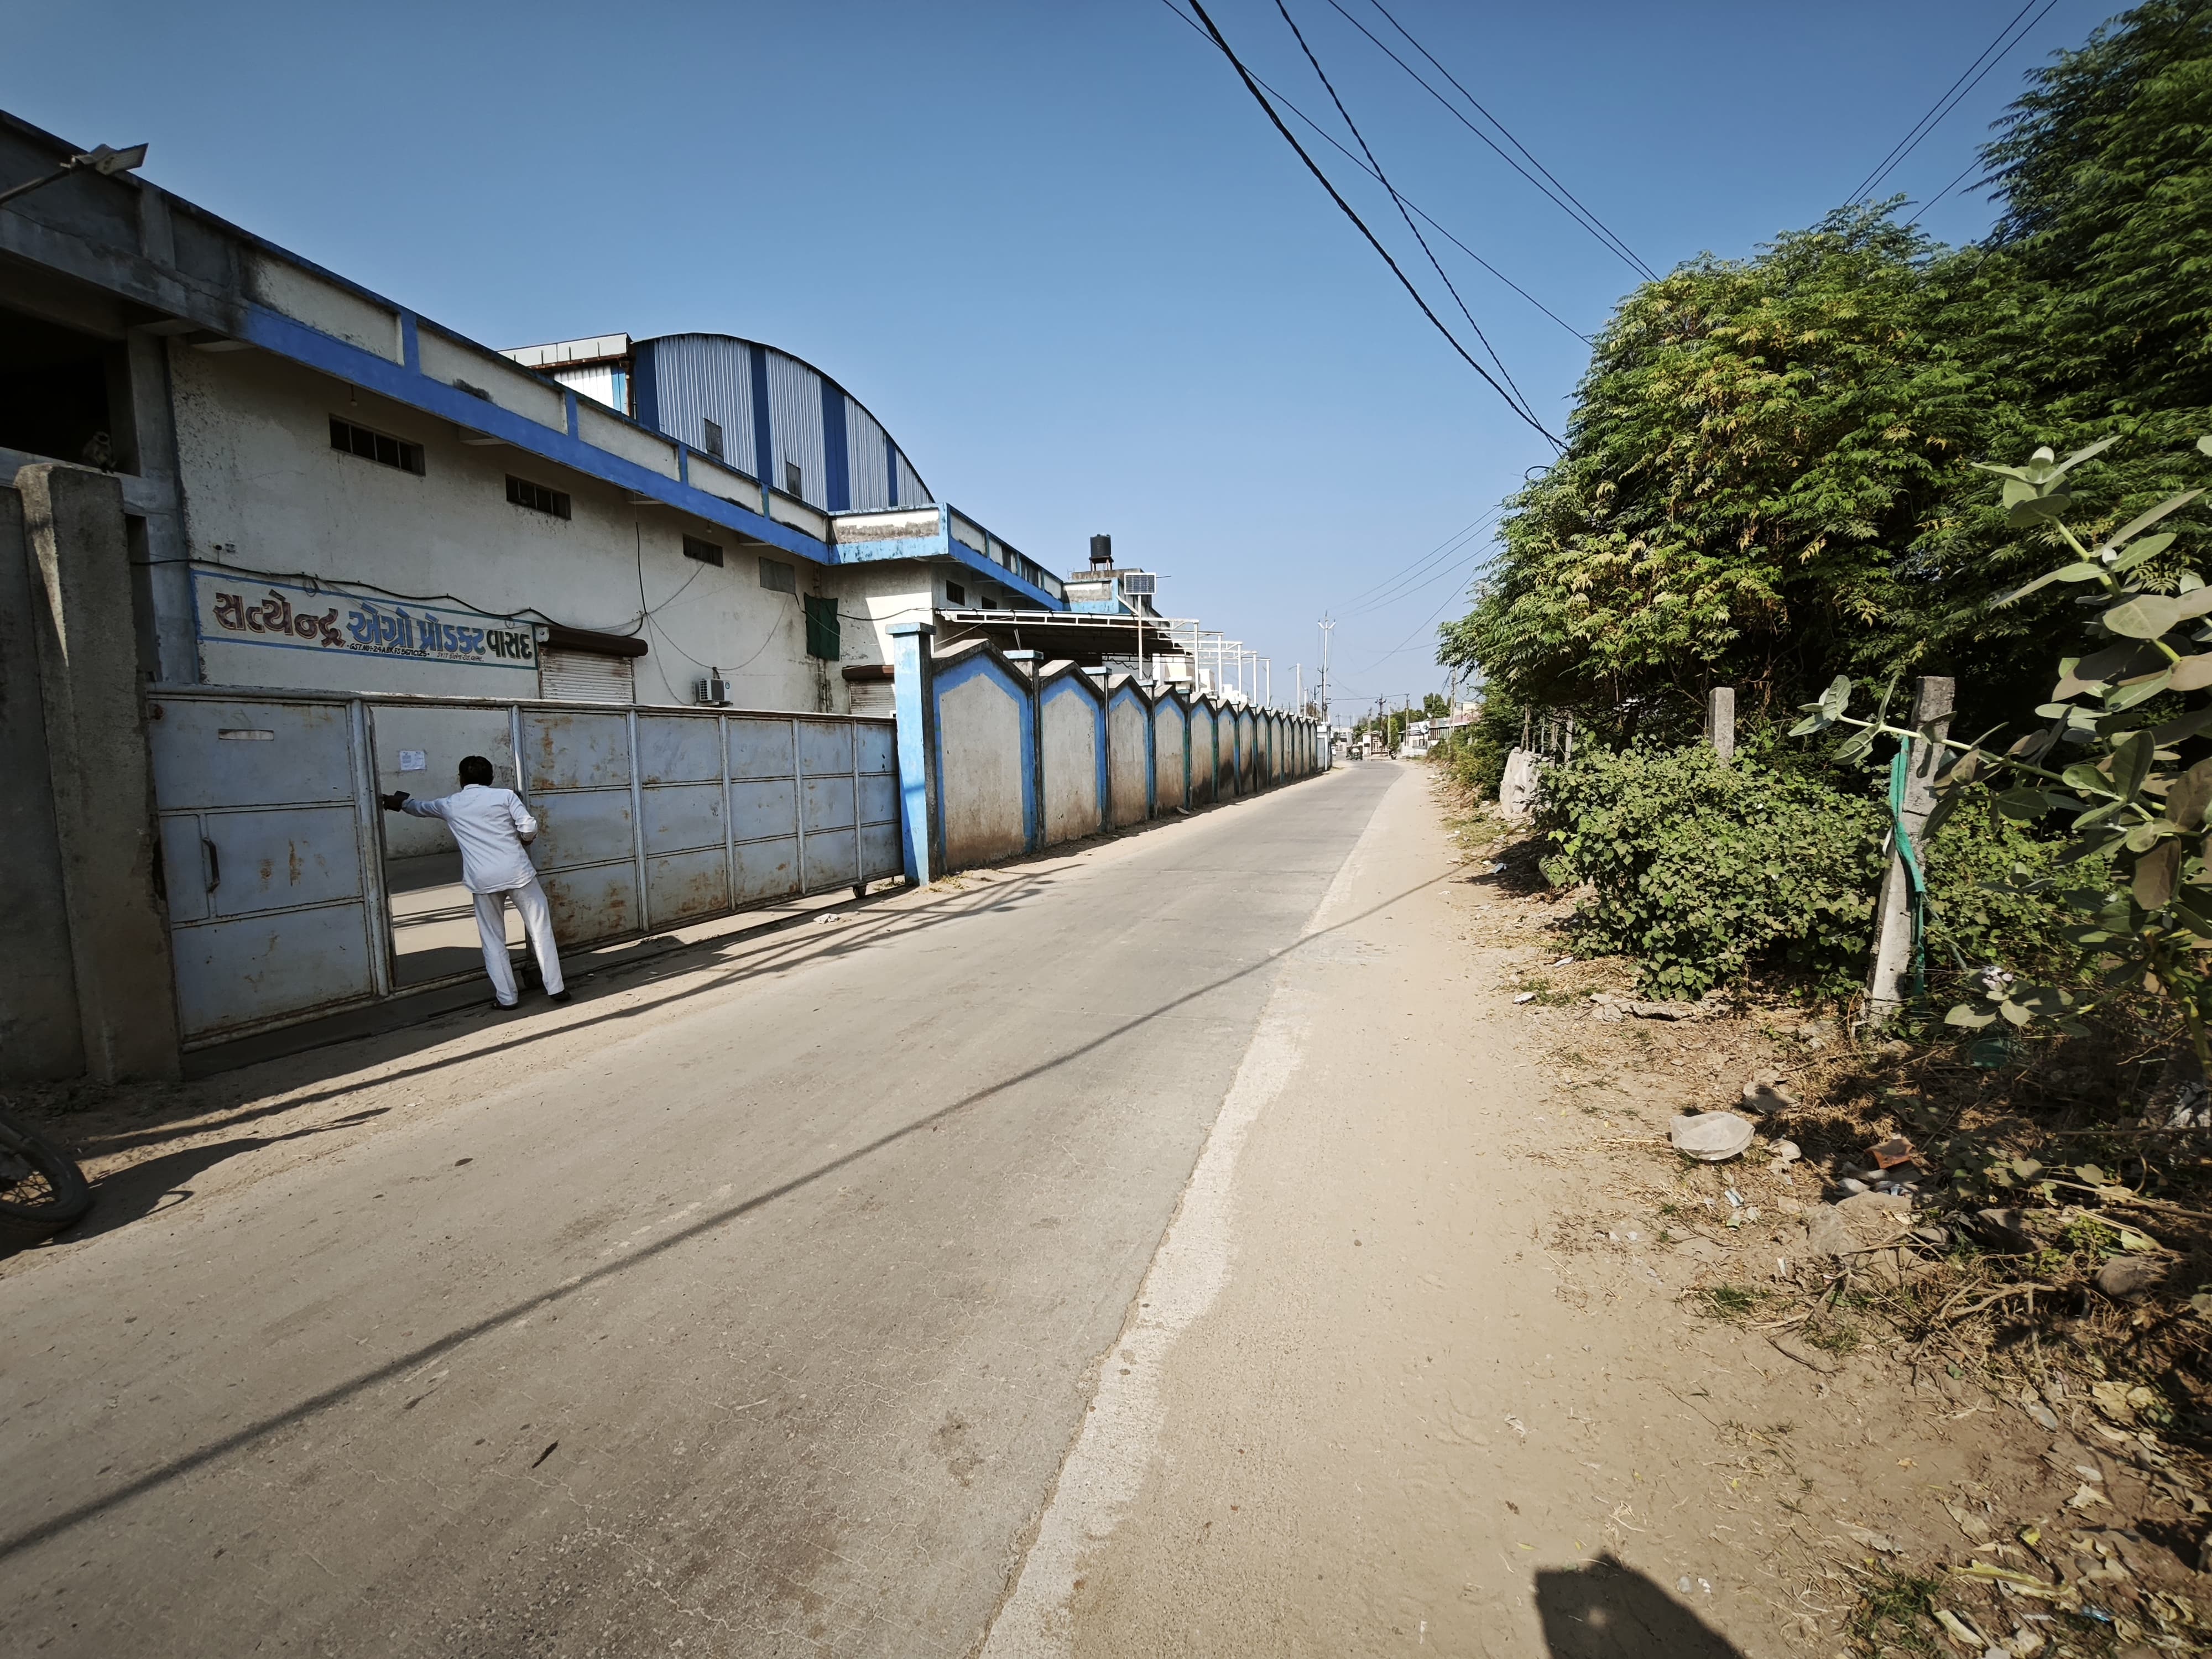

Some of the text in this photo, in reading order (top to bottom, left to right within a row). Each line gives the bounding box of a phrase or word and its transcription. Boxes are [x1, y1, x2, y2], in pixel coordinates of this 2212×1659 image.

[212, 589, 346, 648] સત્યેન્દ્ર
[346, 602, 414, 649] એગ્રો
[487, 629, 533, 659] વાસદ
